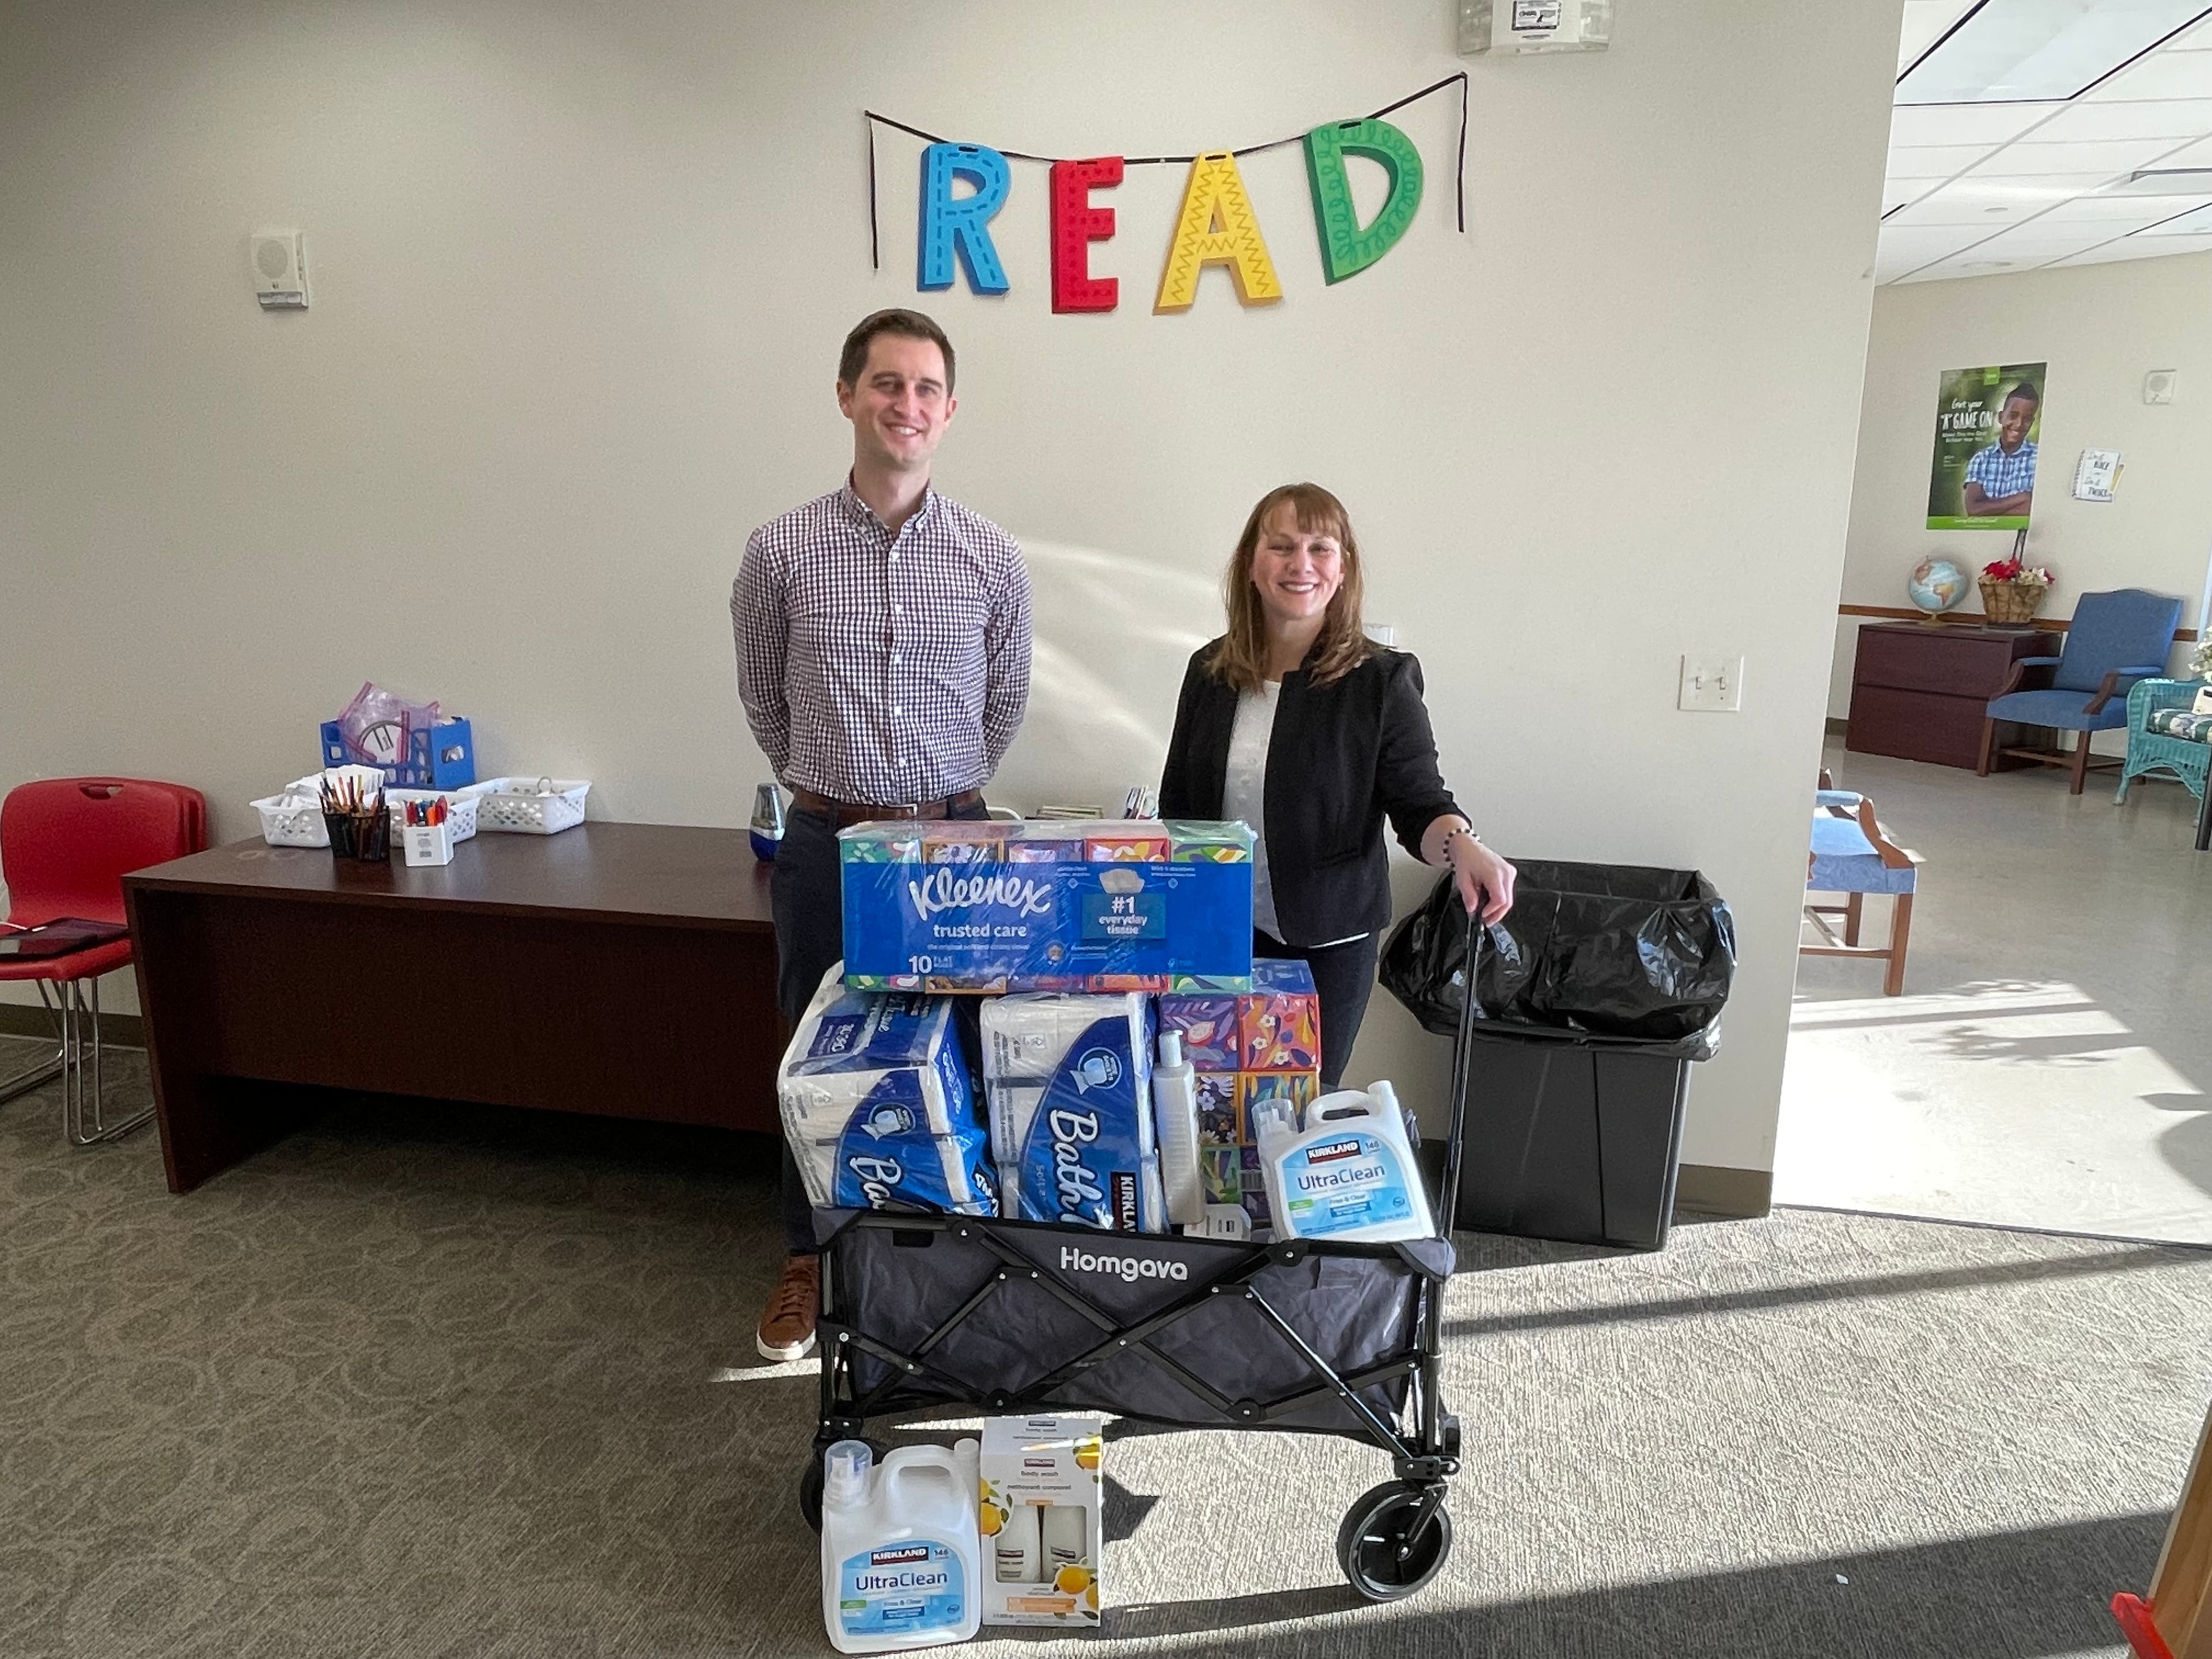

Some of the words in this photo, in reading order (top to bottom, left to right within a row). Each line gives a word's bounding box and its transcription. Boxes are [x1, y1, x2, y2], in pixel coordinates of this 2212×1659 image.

[916, 118, 1423, 315] READ
[908, 867, 1052, 921] Kleenex
[1111, 896, 1135, 914] #1
[1098, 914, 1147, 926] everyday
[933, 923, 990, 938] trusted
[994, 926, 1027, 938] care
[1106, 924, 1139, 935] tissue
[908, 956, 932, 973] 10
[1308, 1142, 1358, 1158] KIRKLAND
[1050, 1109, 1103, 1211] Bath
[849, 1156, 902, 1209] Ba
[1298, 1165, 1385, 1190] UltraClean
[1119, 1176, 1136, 1232] KIRKLA
[1060, 1247, 1187, 1282] Homgava
[873, 1548, 927, 1560] KIRKLAND
[855, 1573, 948, 1590] UltraClean
